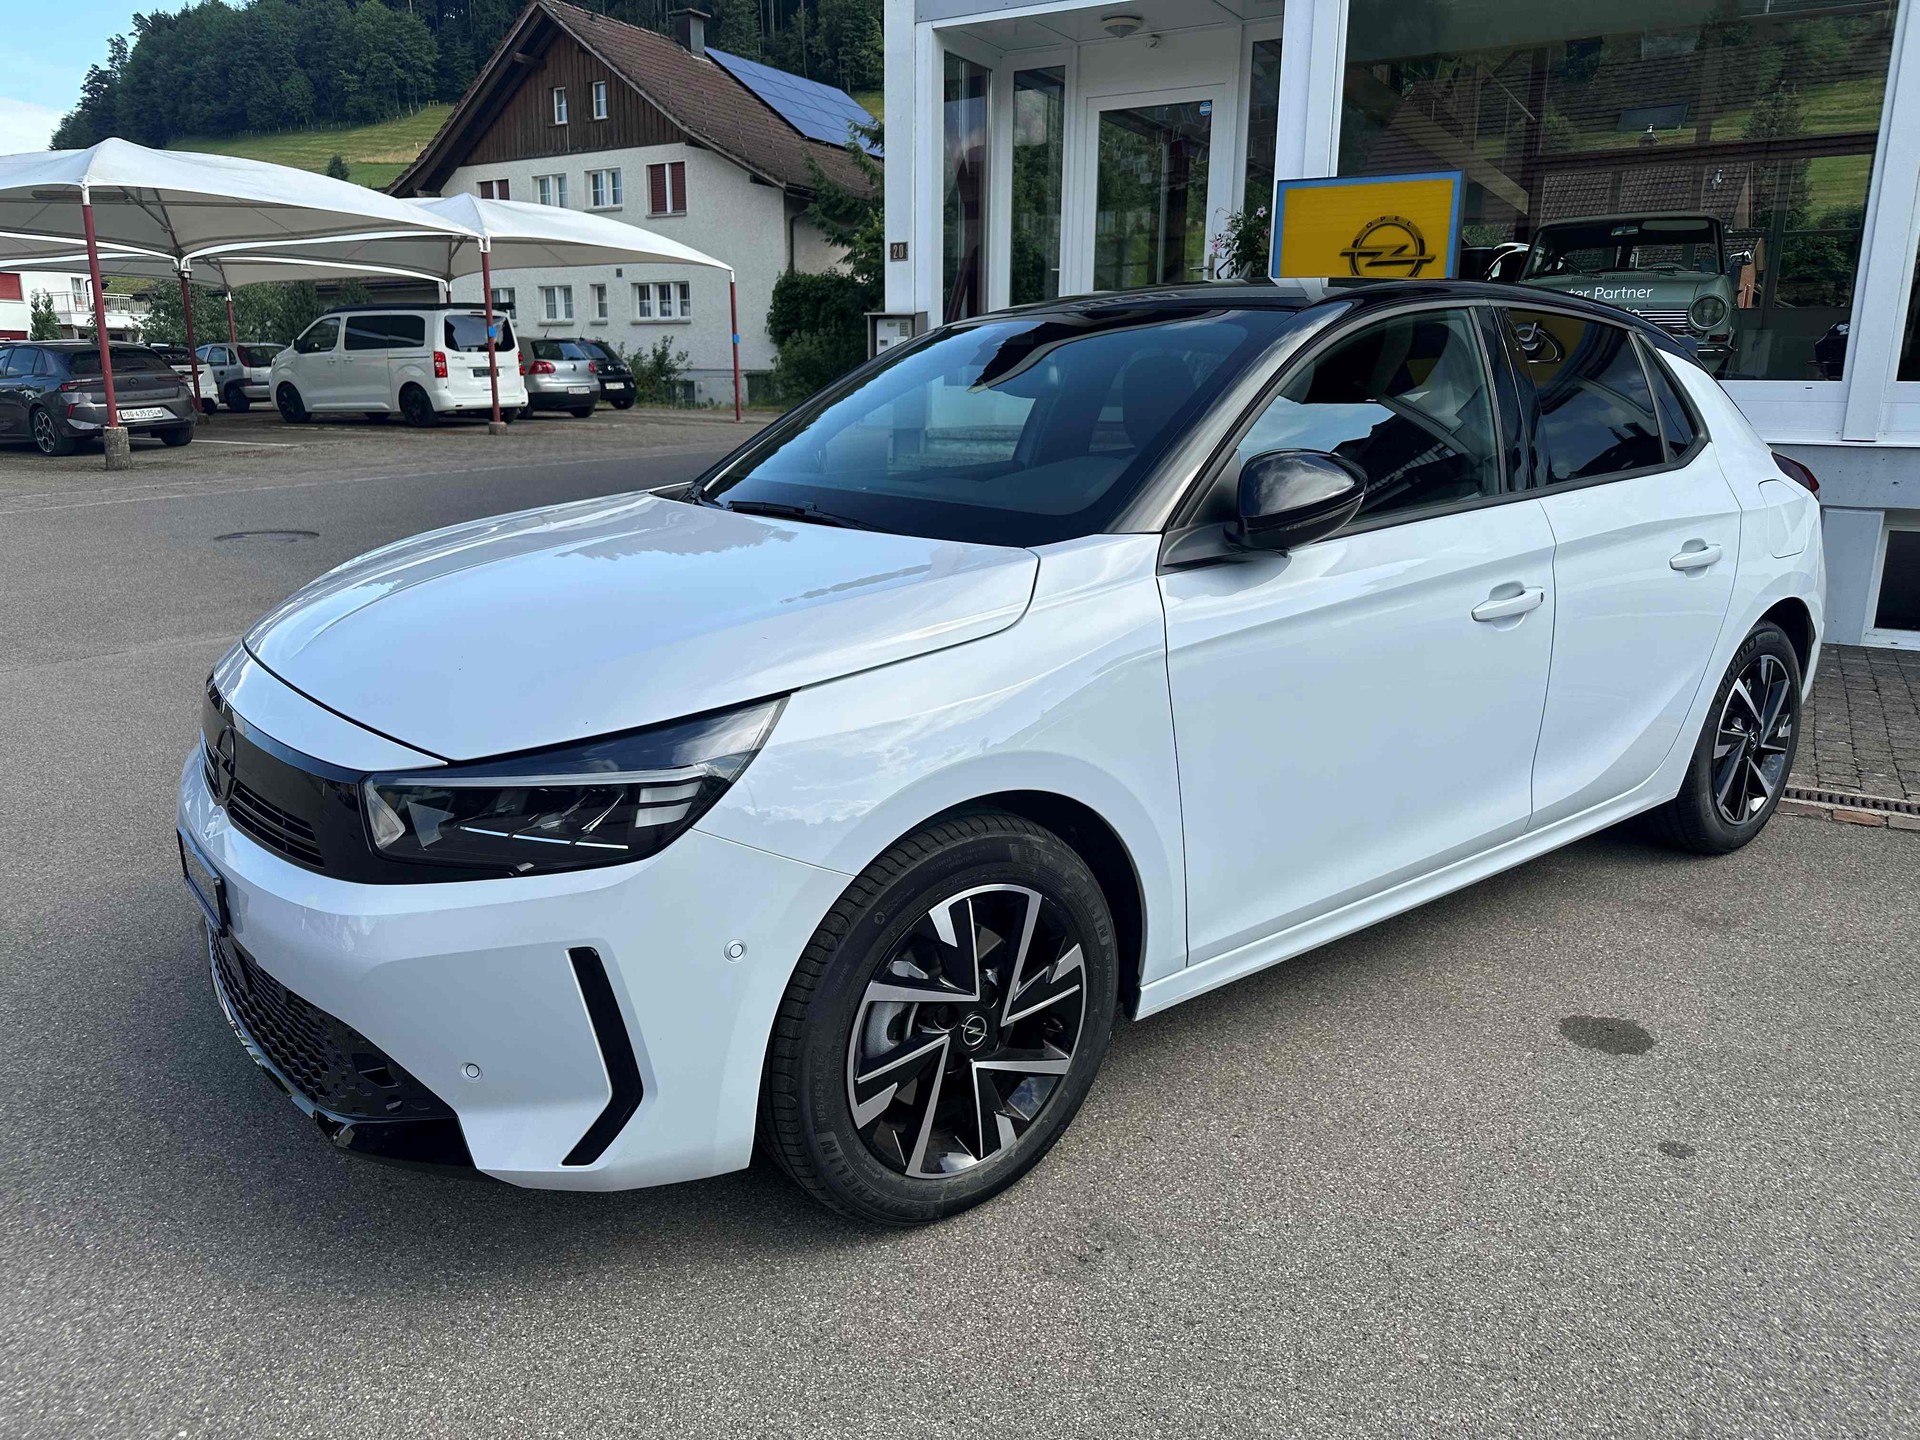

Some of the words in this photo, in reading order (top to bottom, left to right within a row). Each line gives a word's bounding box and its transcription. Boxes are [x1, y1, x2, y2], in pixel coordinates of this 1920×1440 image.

[1366, 216, 1412, 229] OPEL
[892, 243, 905, 259] 20
[1594, 286, 1654, 300] Partner
